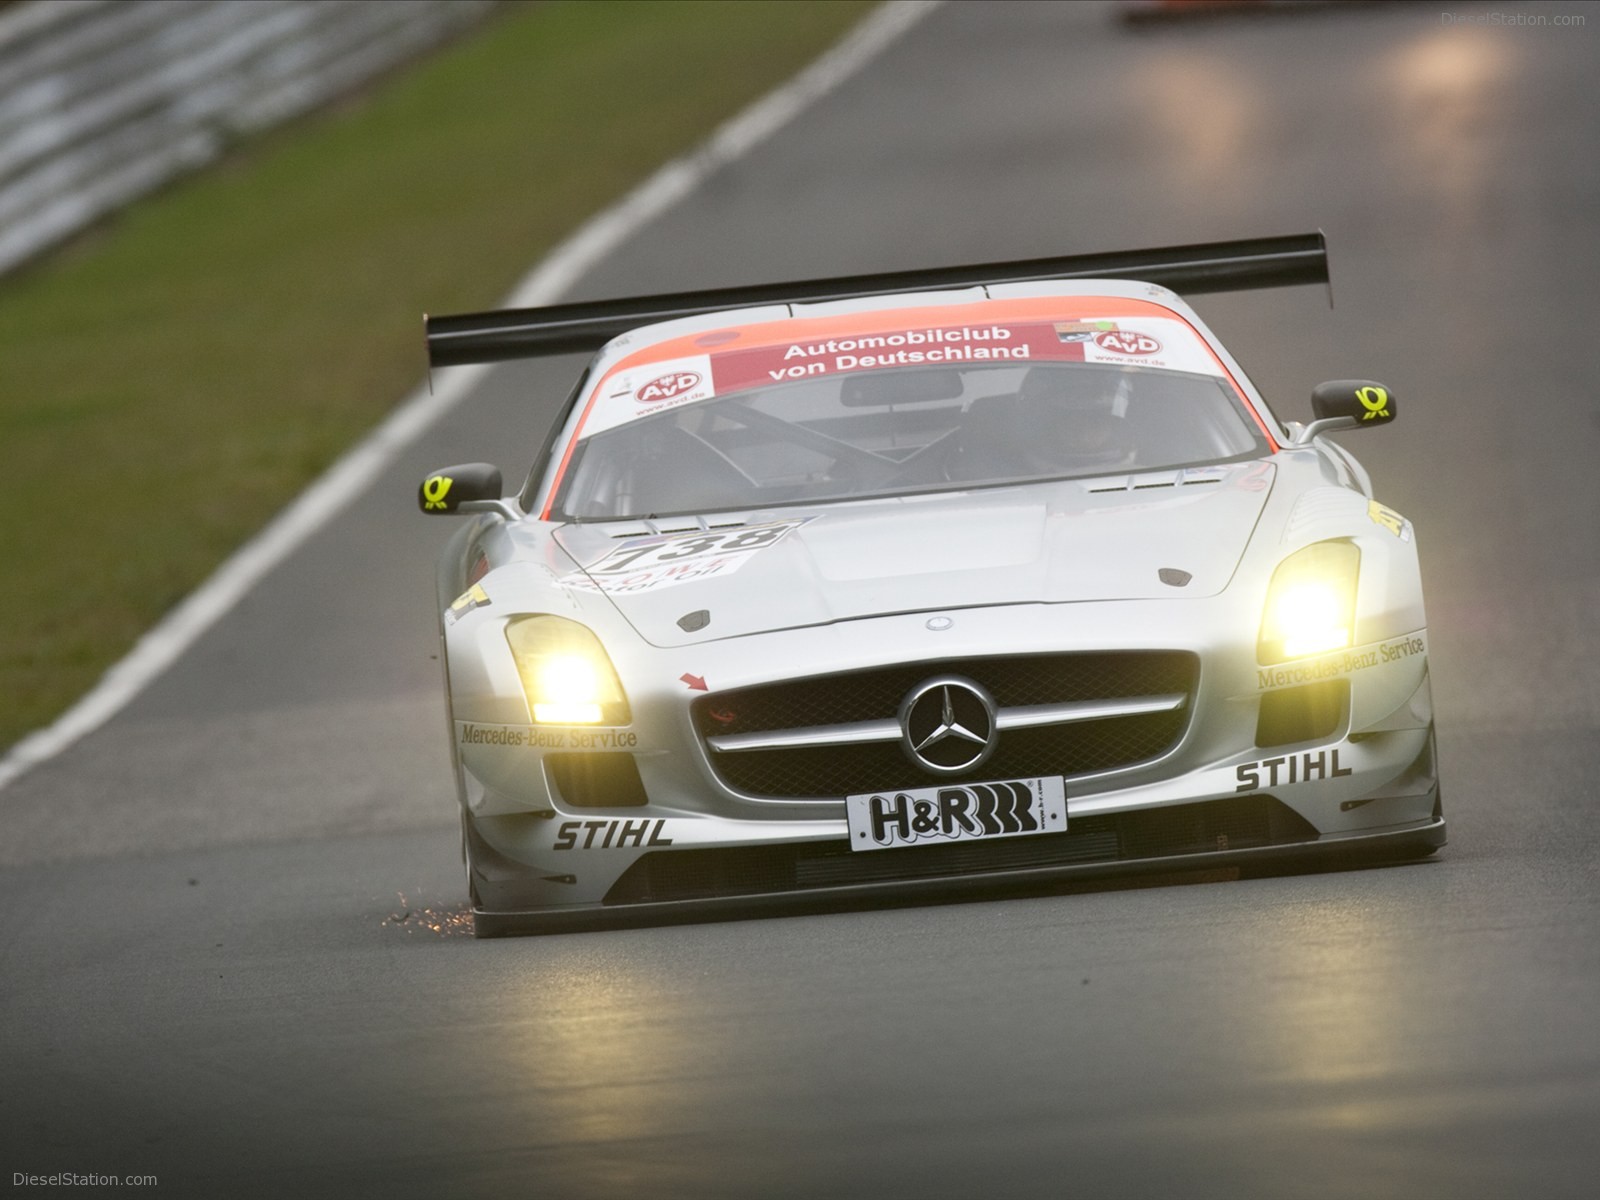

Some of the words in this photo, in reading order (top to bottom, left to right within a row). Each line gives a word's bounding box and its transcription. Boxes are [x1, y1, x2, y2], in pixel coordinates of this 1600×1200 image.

[784, 326, 1011, 360] Automobilclub
[768, 361, 826, 381] von
[836, 343, 1030, 371] Deutschland
[1095, 355, 1166, 366] www.avd.de
[636, 392, 705, 416] www.avd.de
[601, 525, 787, 571] 738
[1257, 652, 1378, 690] Mercedes-Benz
[1379, 637, 1425, 664] Service
[461, 724, 565, 748] Mercedes-Benz
[569, 729, 638, 749] Service
[1235, 749, 1353, 793] STIHL
[553, 819, 674, 851] STIHL
